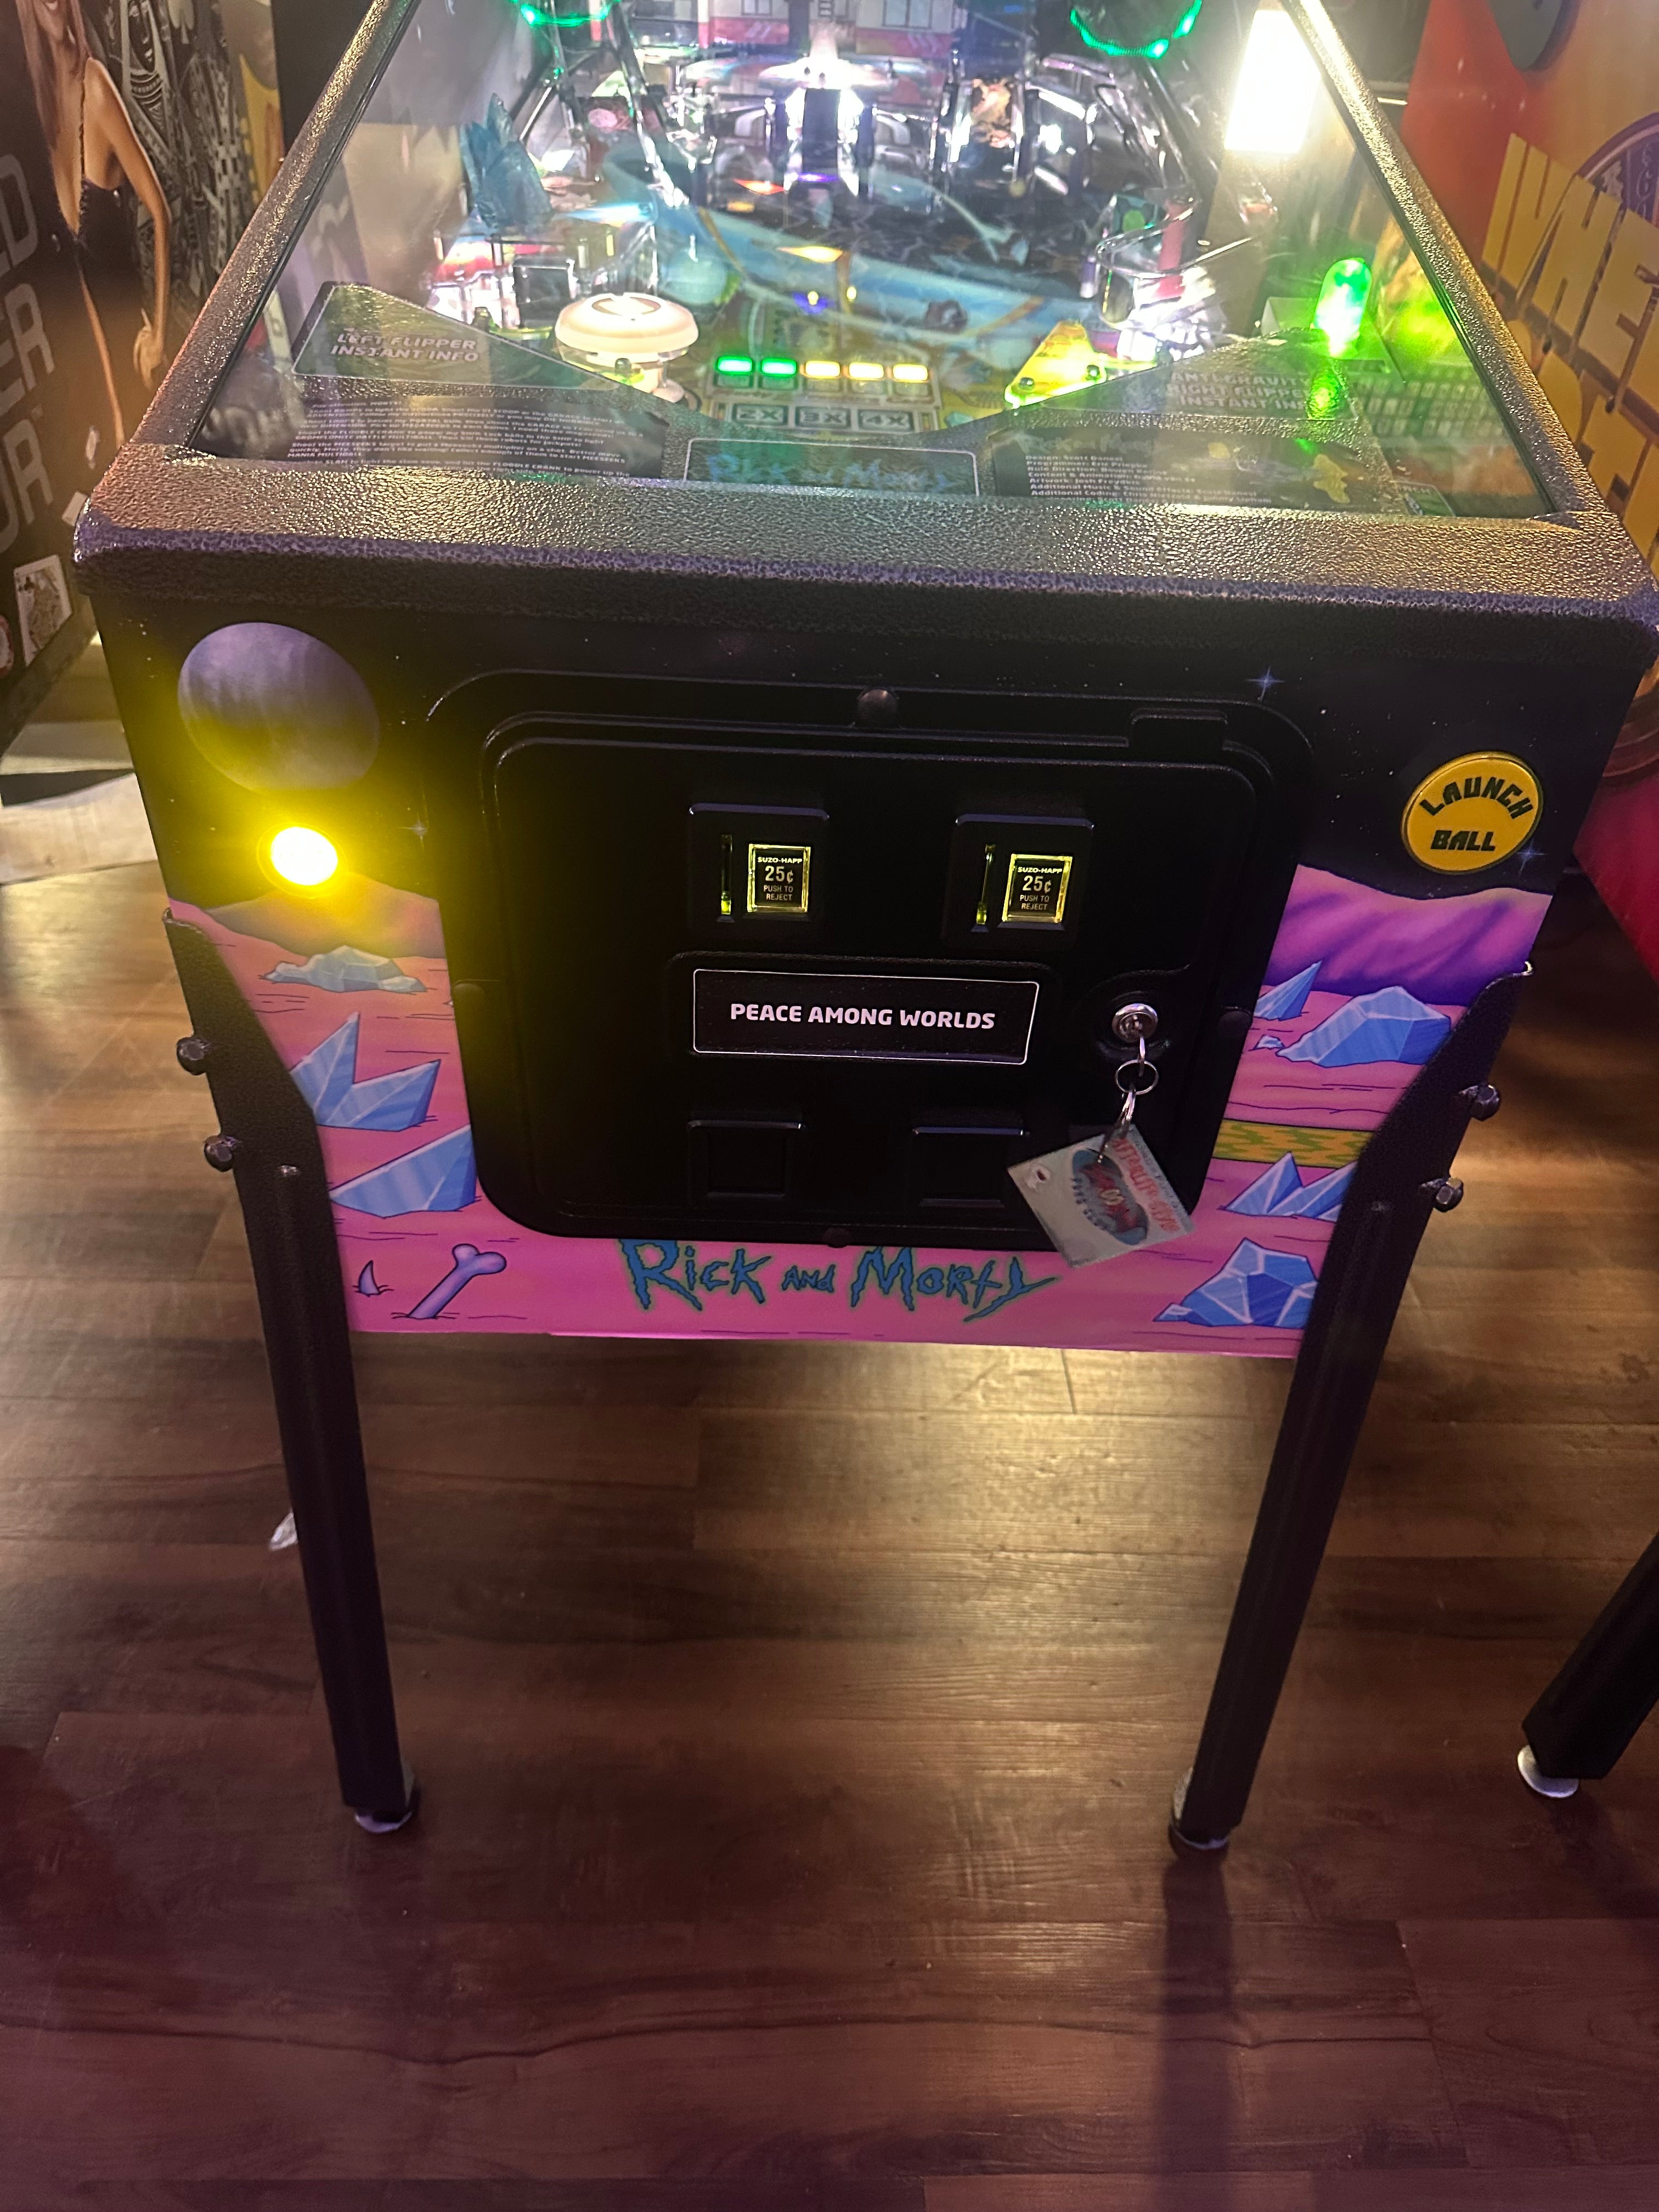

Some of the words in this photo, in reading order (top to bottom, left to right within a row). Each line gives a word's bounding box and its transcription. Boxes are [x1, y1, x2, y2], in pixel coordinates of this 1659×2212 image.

[337, 334, 383, 344] LEFT
[390, 337, 477, 350] FLIPPER
[330, 345, 423, 359] INSTANT
[429, 351, 478, 362] INFO
[1179, 394, 1267, 409] INSTANT
[1234, 387, 1310, 399] FLIPPE
[738, 410, 780, 421] 2X
[803, 412, 844, 423] 3X
[865, 415, 905, 426] 4X
[1419, 776, 1533, 819] LAUNCH
[1431, 830, 1496, 851] BALL
[765, 865, 794, 884] 25¢
[1022, 875, 1052, 893] 25¢
[731, 1003, 802, 1023] PEACE
[808, 1006, 892, 1026] AMONG
[900, 1009, 996, 1030] WORLDS
[619, 1239, 771, 1311] Rick
[851, 1246, 1057, 1322] Morty
